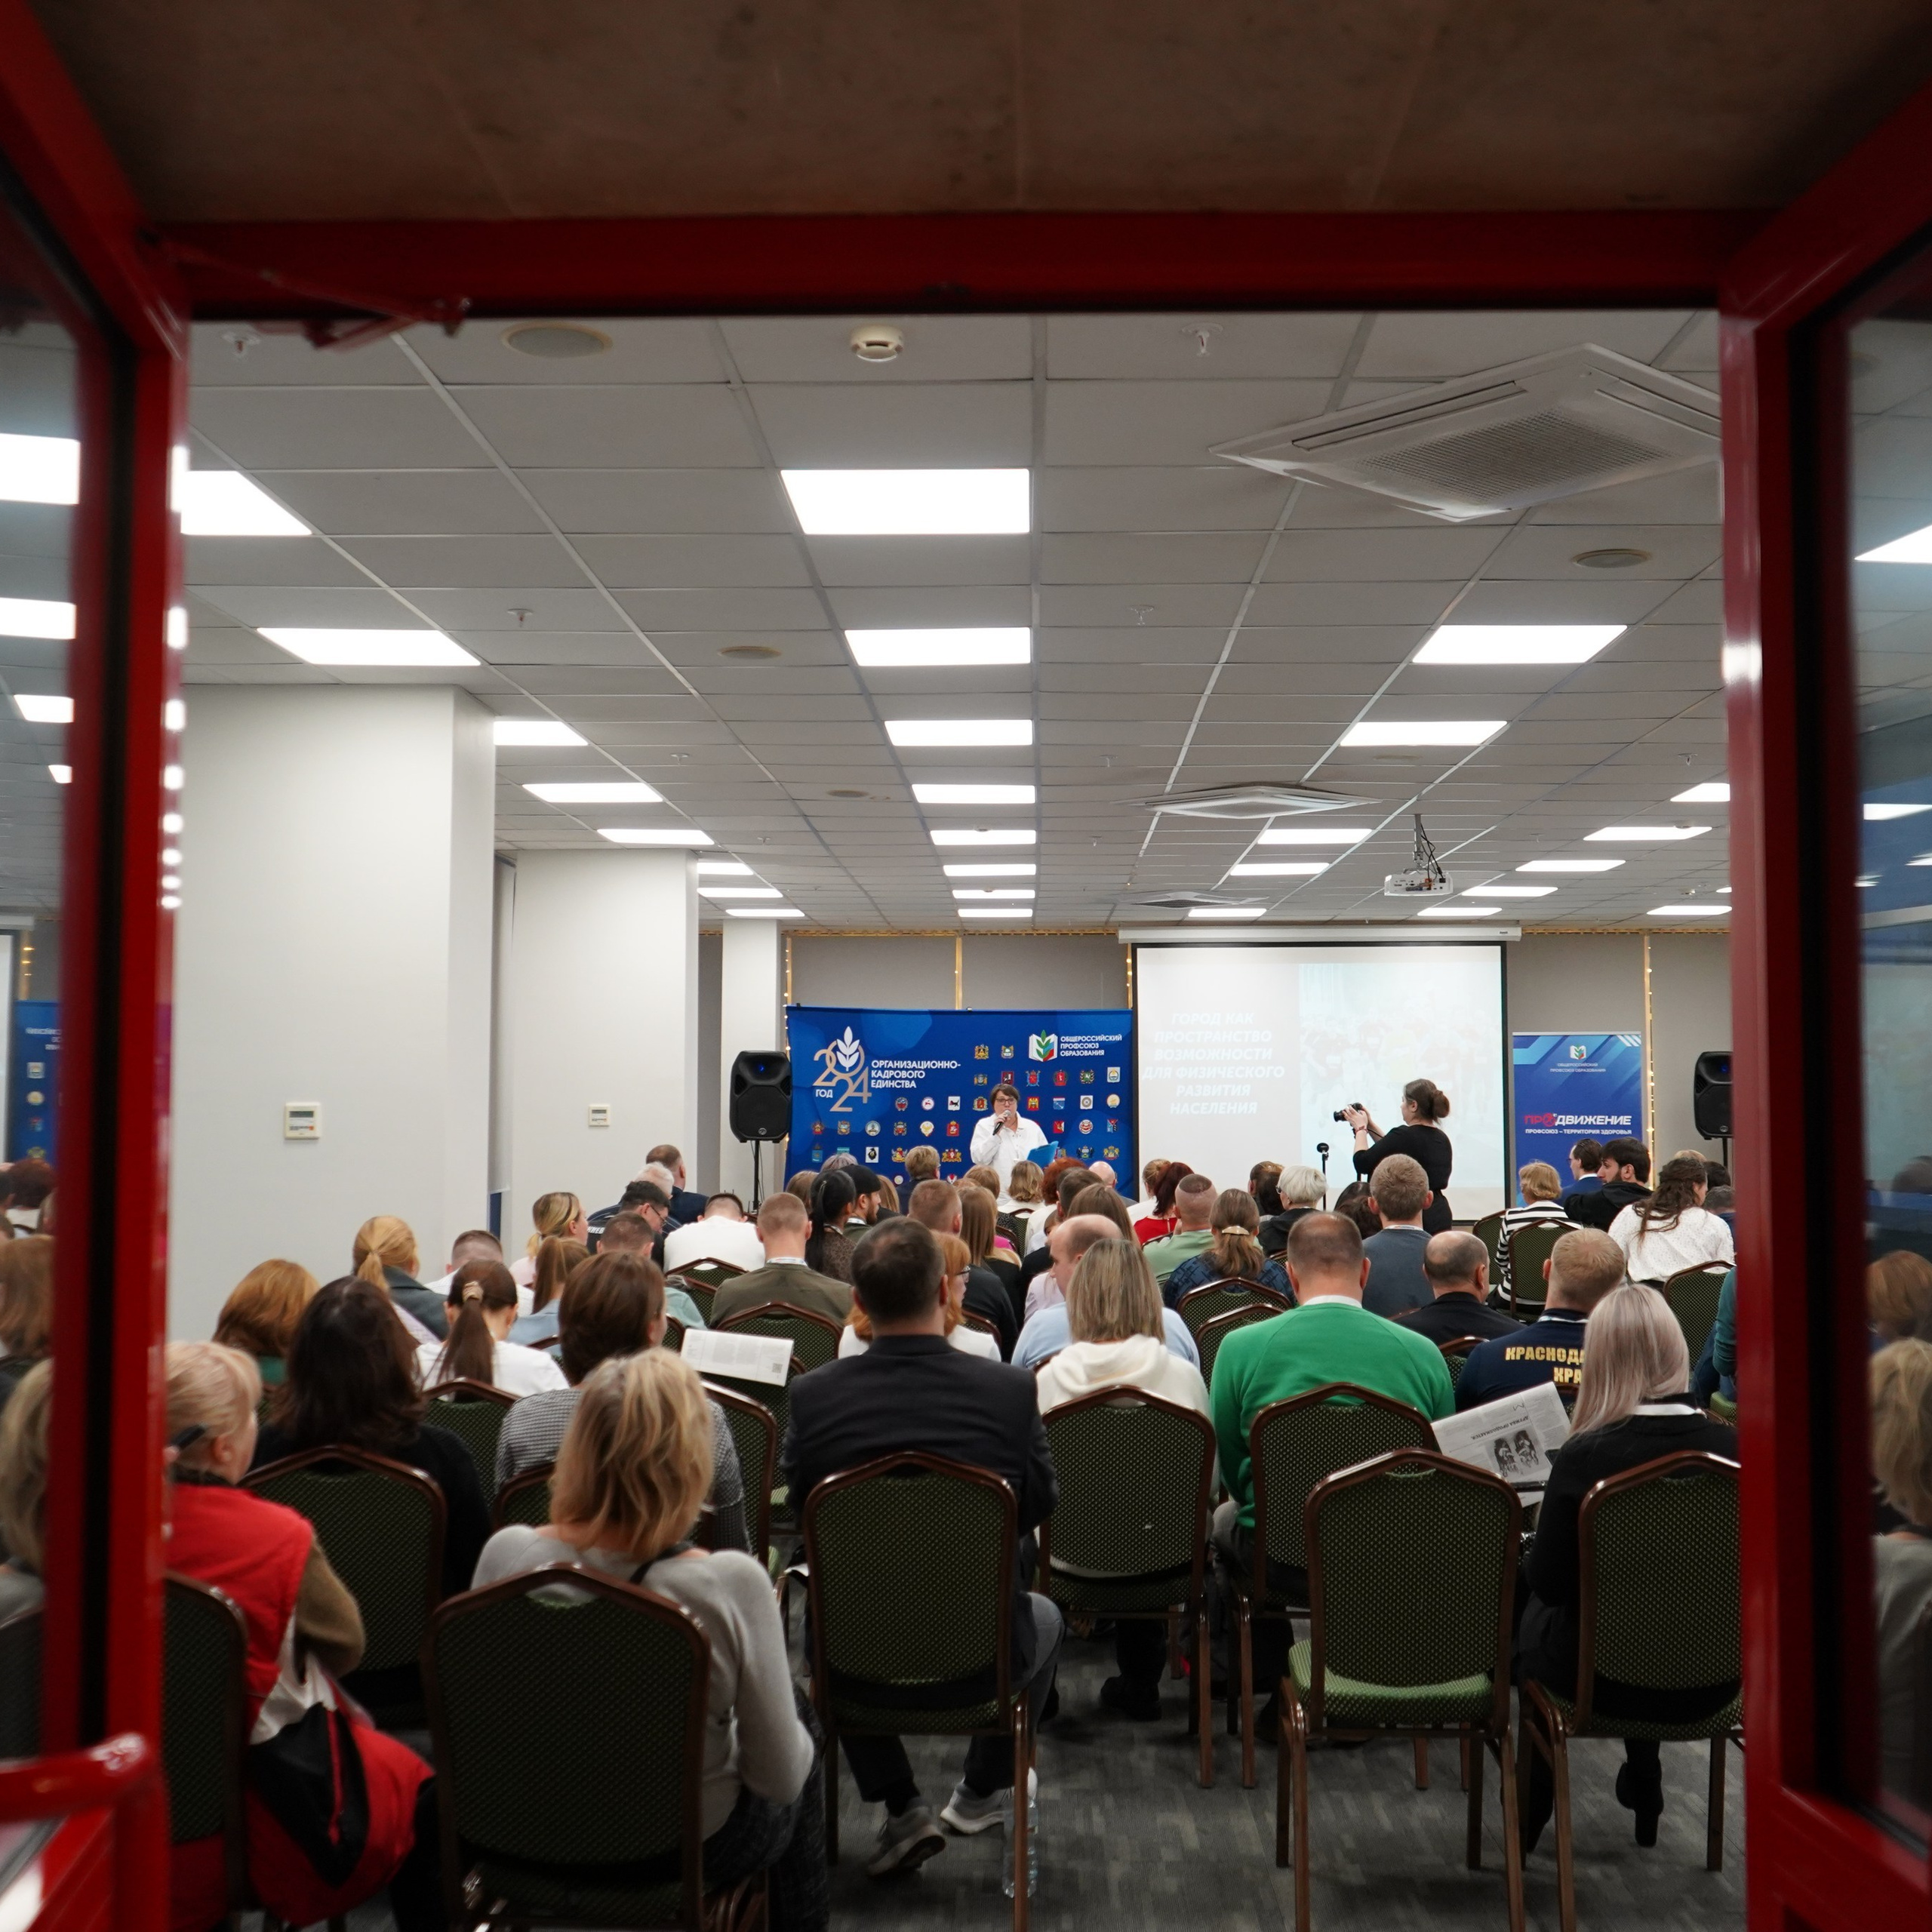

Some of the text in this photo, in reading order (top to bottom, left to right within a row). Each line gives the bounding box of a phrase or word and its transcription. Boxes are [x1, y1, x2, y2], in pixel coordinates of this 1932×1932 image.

[1171, 1012, 1254, 1026] ГОРОД КАК
[1060, 1034, 1122, 1042] ОБЩЕРОССИЙСКИЙ
[1154, 1030, 1272, 1043] ПРОСТРАНСТВО
[1154, 1048, 1272, 1061] ВОЗМОЖНОСТИ
[871, 1060, 961, 1069] ОРГАНИЗАЦИОННО-
[871, 1070, 925, 1079] КАДРОВОГО
[1142, 1066, 1285, 1081] ДЛЯ ФИЗИЧЕСКОГО
[871, 1079, 916, 1088] ЕДИНСТВА
[815, 1089, 833, 1098] ГОД
[1176, 1084, 1251, 1097] РАЗВИТИЯ
[1170, 1101, 1258, 1115] НАСЕЛЕНИЯ
[1554, 1367, 1582, 1384] КРА
